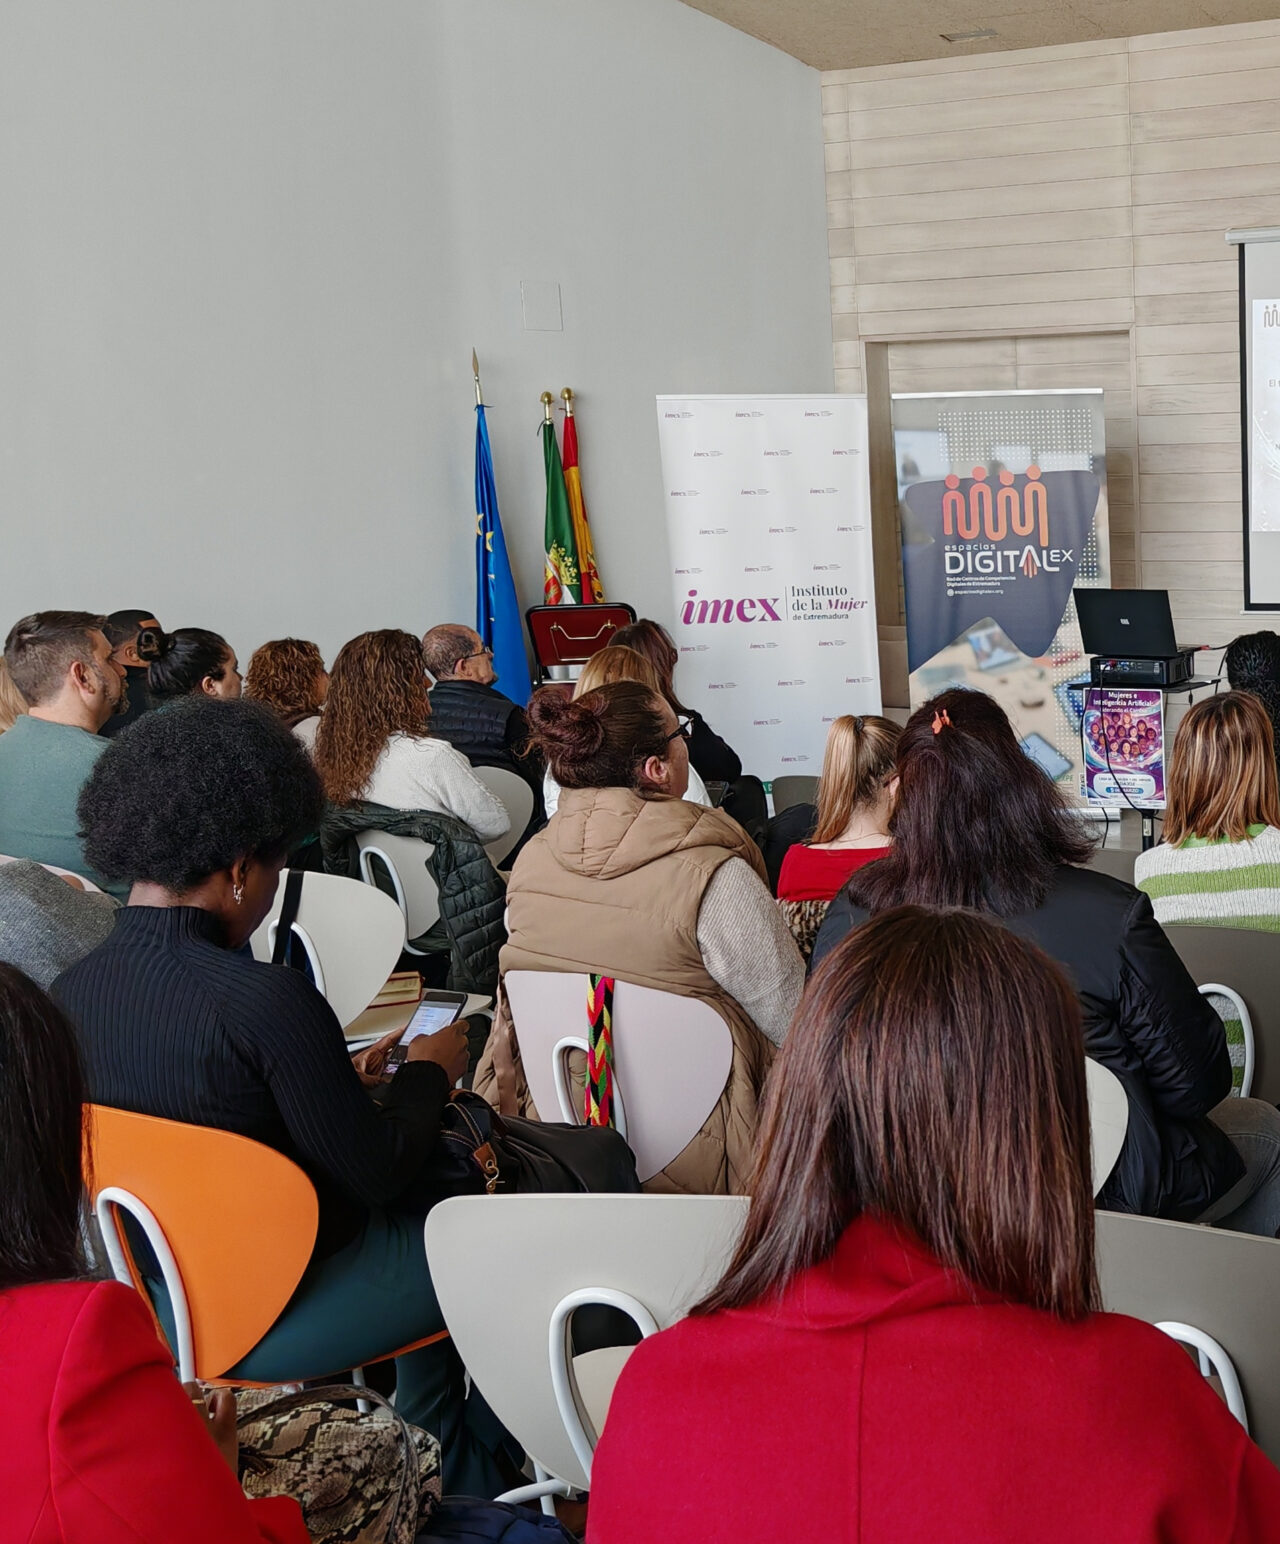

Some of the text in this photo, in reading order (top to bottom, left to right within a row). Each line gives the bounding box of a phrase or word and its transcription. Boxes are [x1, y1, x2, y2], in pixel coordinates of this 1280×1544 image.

[944, 543, 996, 552] espacios
[680, 584, 848, 625] imex Instituto
[792, 598, 868, 612] de la Mujer
[803, 613, 849, 621] Extremadura
